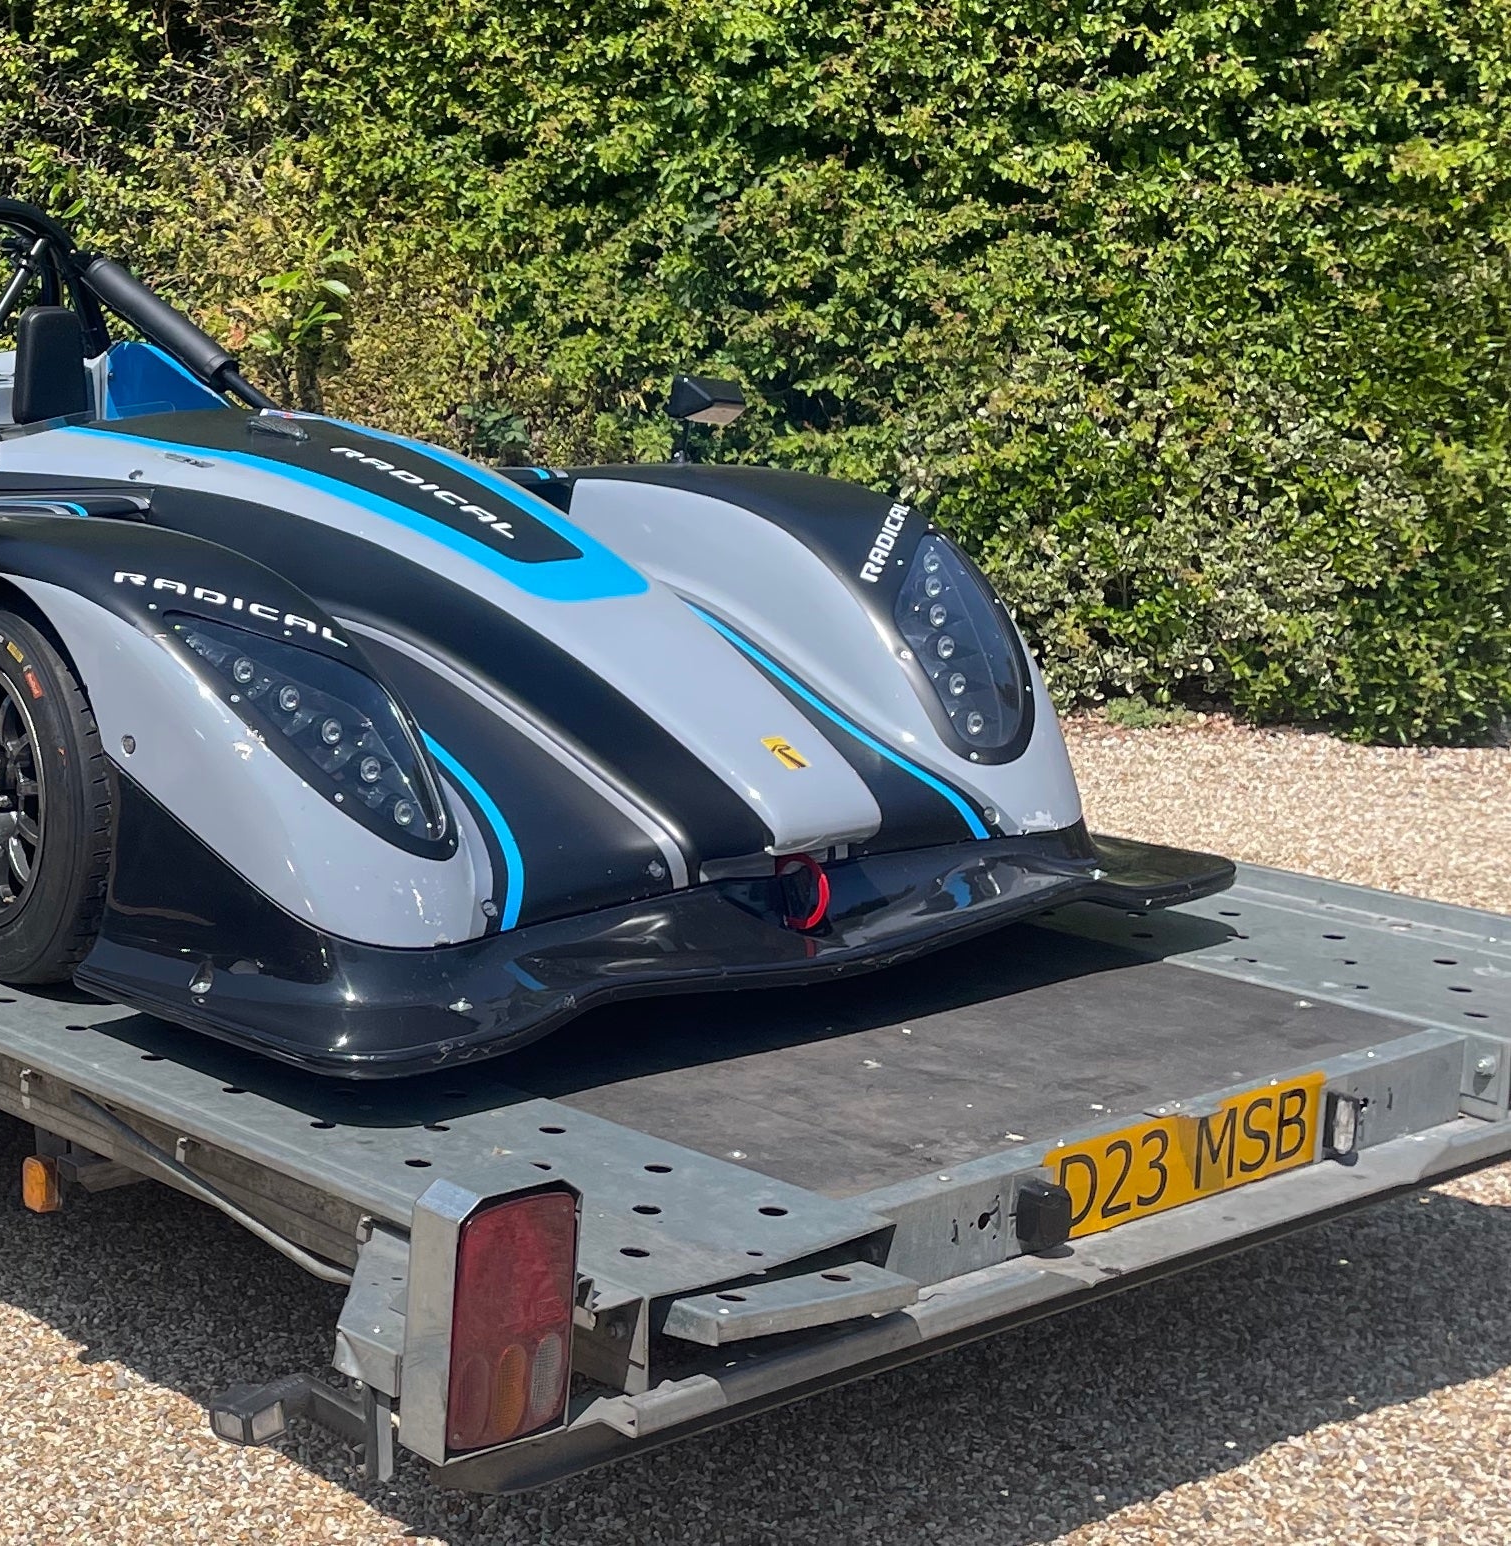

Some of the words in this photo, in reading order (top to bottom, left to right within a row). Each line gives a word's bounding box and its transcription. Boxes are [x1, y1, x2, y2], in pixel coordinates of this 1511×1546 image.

[330, 447, 515, 539] RADICAL
[860, 502, 911, 583] RADICAL
[113, 571, 349, 648] RADICAL
[1059, 1128, 1169, 1227] D23
[1194, 1088, 1307, 1190] MSB
